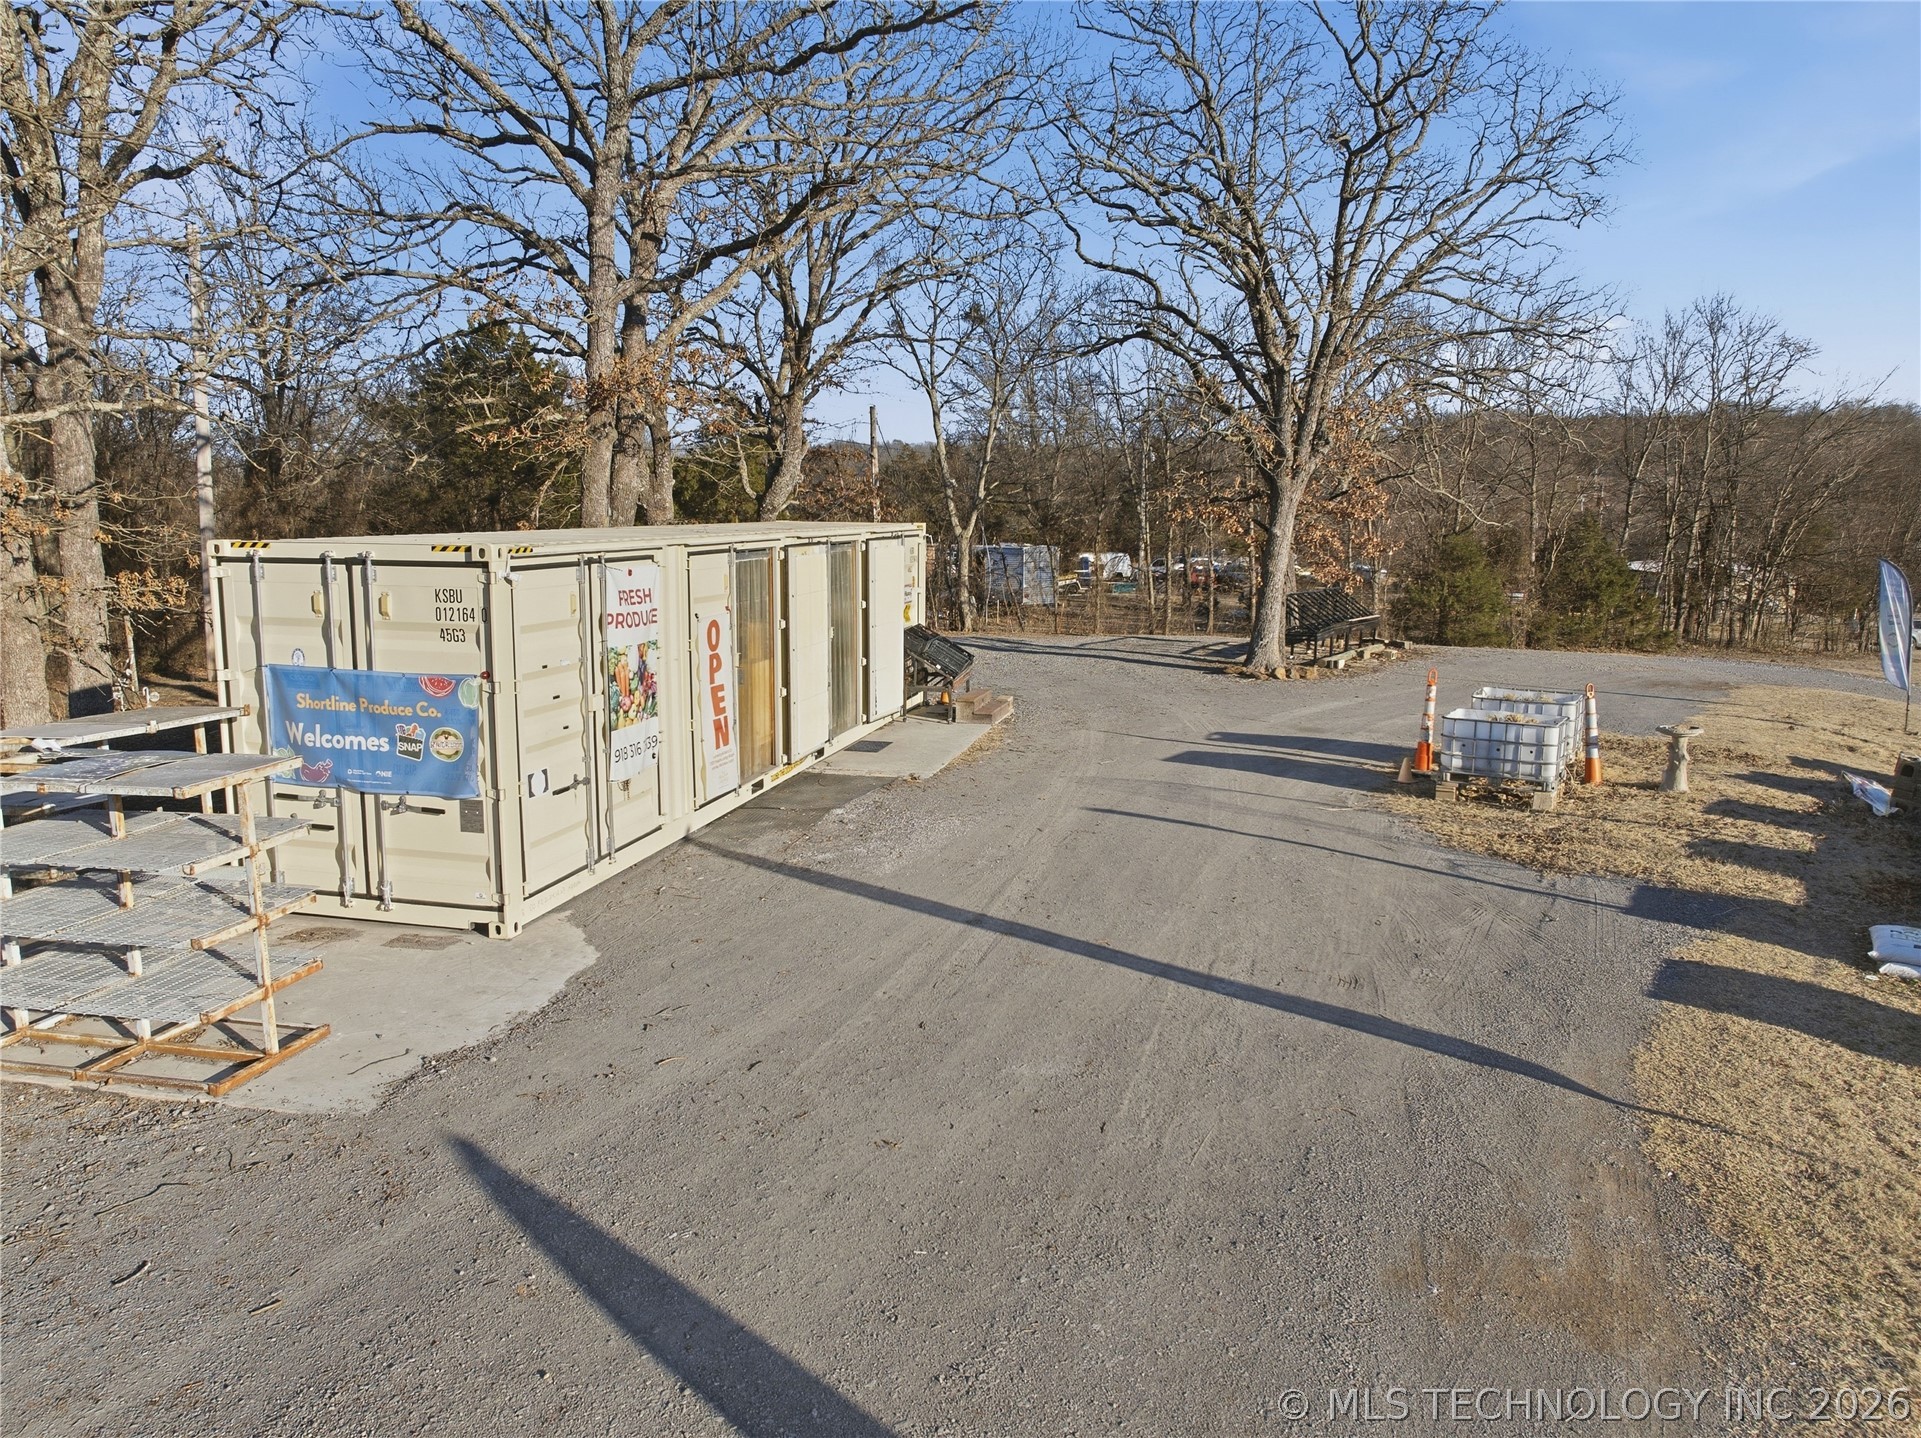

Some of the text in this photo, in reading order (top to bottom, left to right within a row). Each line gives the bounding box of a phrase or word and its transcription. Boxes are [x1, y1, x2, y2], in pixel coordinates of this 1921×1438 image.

[434, 589, 463, 603] KSBU
[618, 588, 652, 606] FRESH
[435, 607, 475, 622] 012164
[439, 628, 466, 643] 45G3
[706, 619, 730, 751] OPEN
[296, 693, 442, 717] Shortline Produce Co.
[285, 720, 390, 752] Welcomes
[398, 742, 423, 752] SNAP
[629, 741, 642, 758] 316
